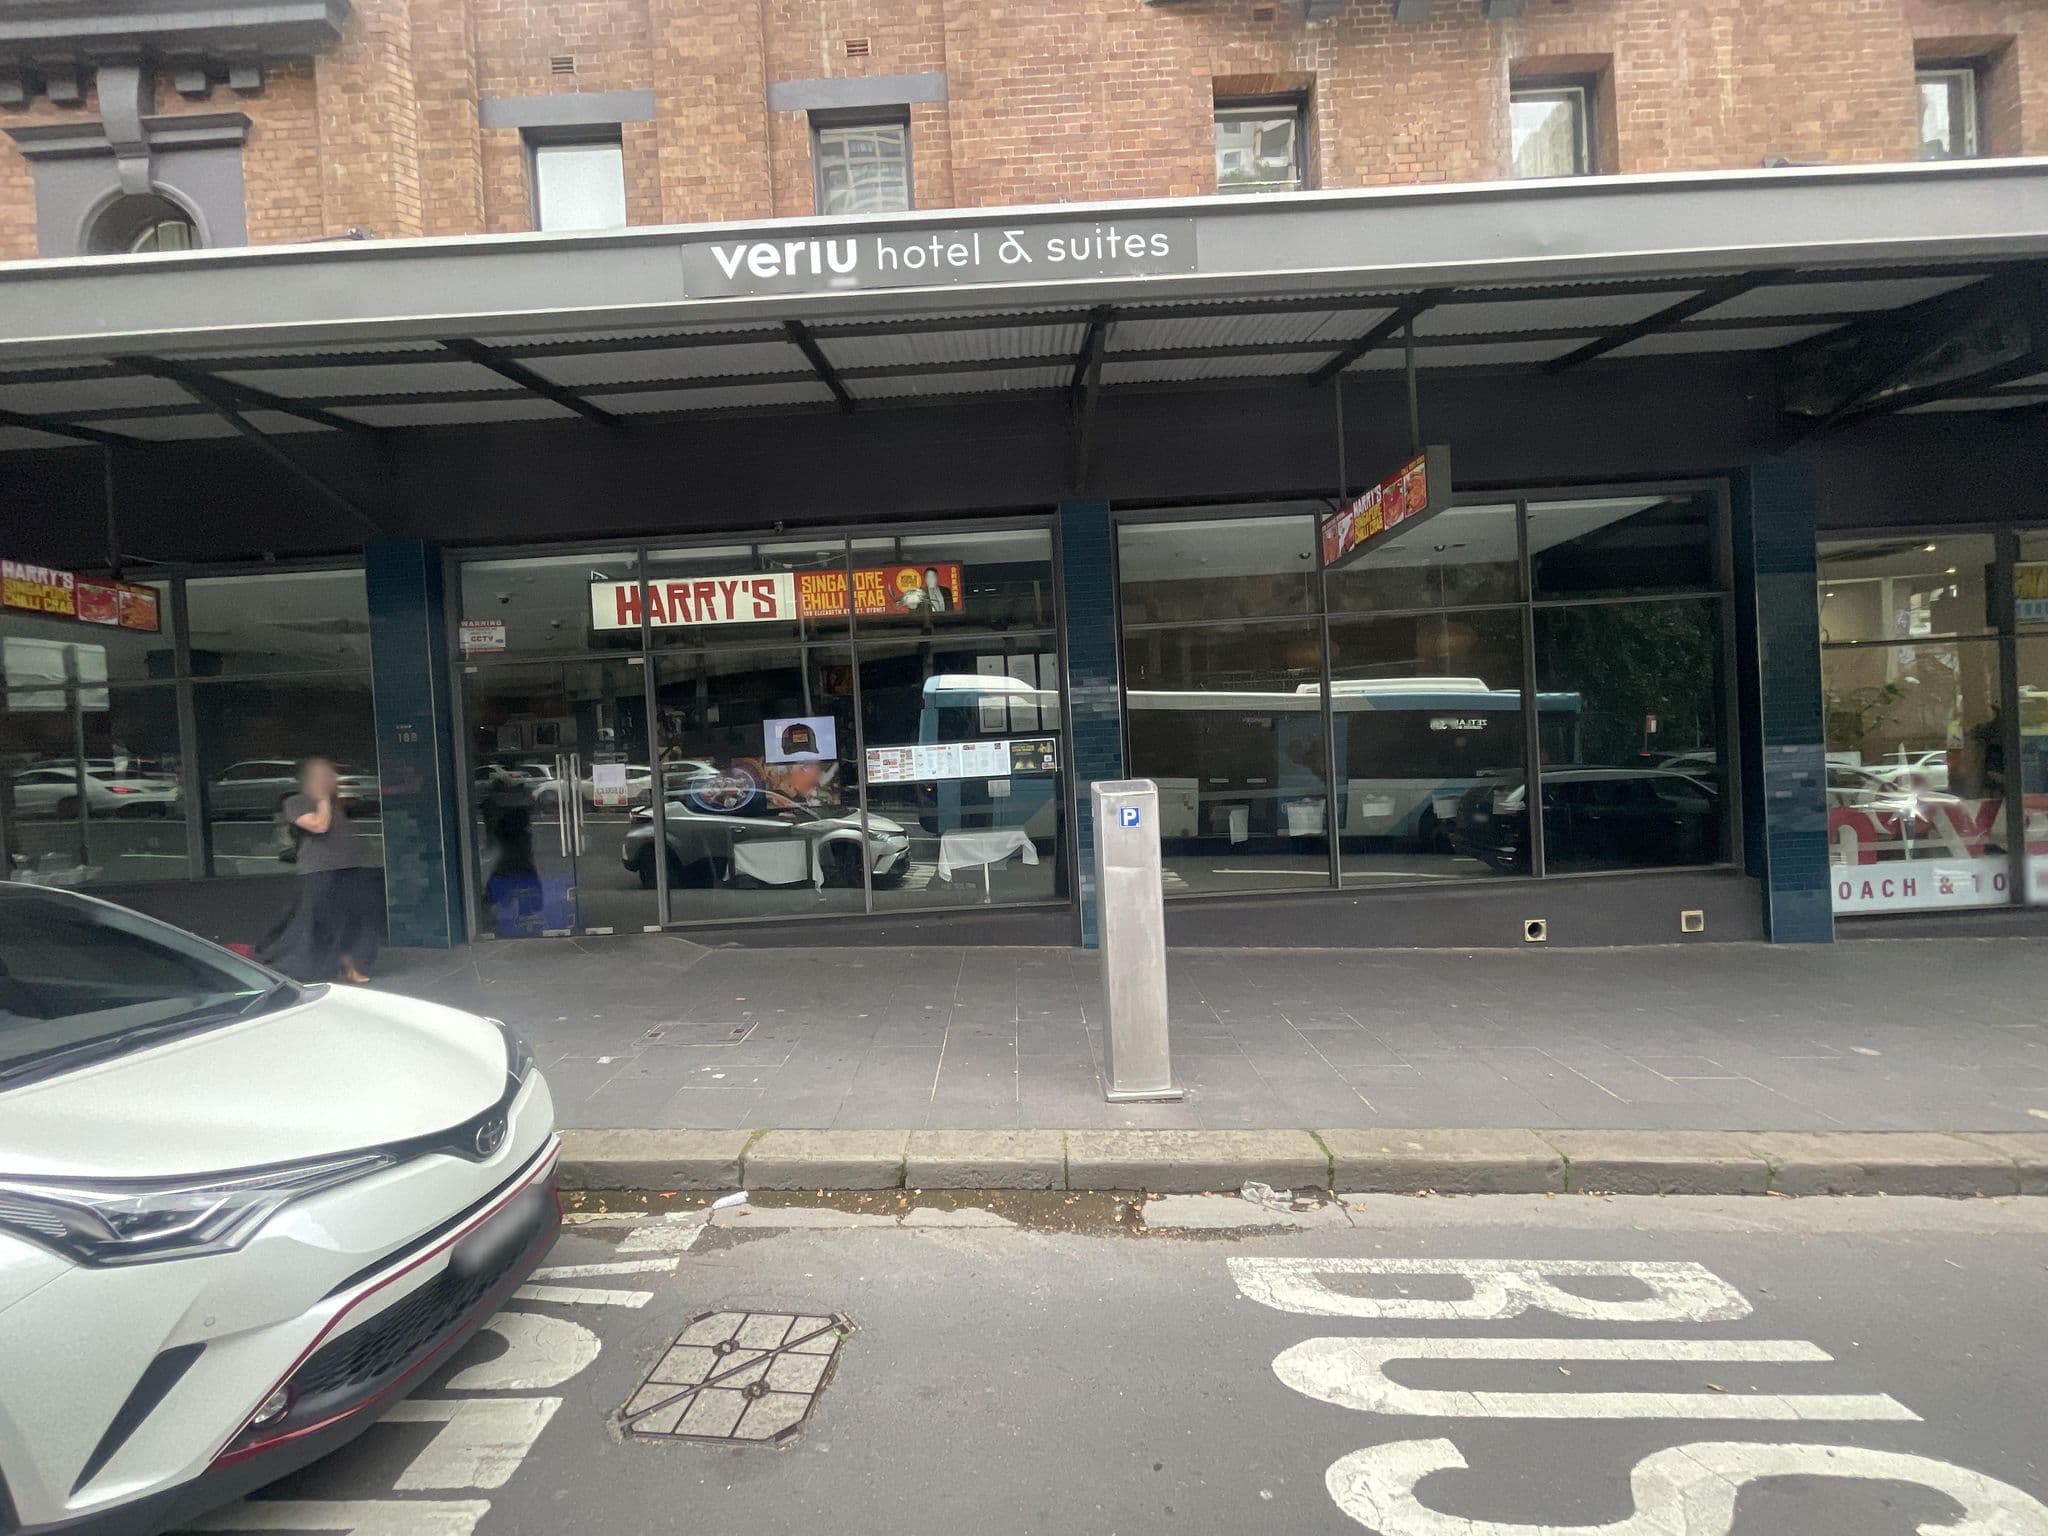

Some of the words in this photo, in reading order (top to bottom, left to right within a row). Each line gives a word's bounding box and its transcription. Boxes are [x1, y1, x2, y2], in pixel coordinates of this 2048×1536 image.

[710, 239, 858, 280] veriu
[878, 232, 980, 270] hotel
[998, 230, 1033, 264] &
[1047, 227, 1170, 262] suites
[2, 560, 74, 590] HARRY'S
[801, 571, 884, 593] SINGAORE
[616, 579, 777, 625] HARRY'S
[803, 591, 844, 610] CHILLI
[852, 590, 886, 608] RAB
[1123, 808, 1137, 826] P
[1939, 875, 1954, 895] &
